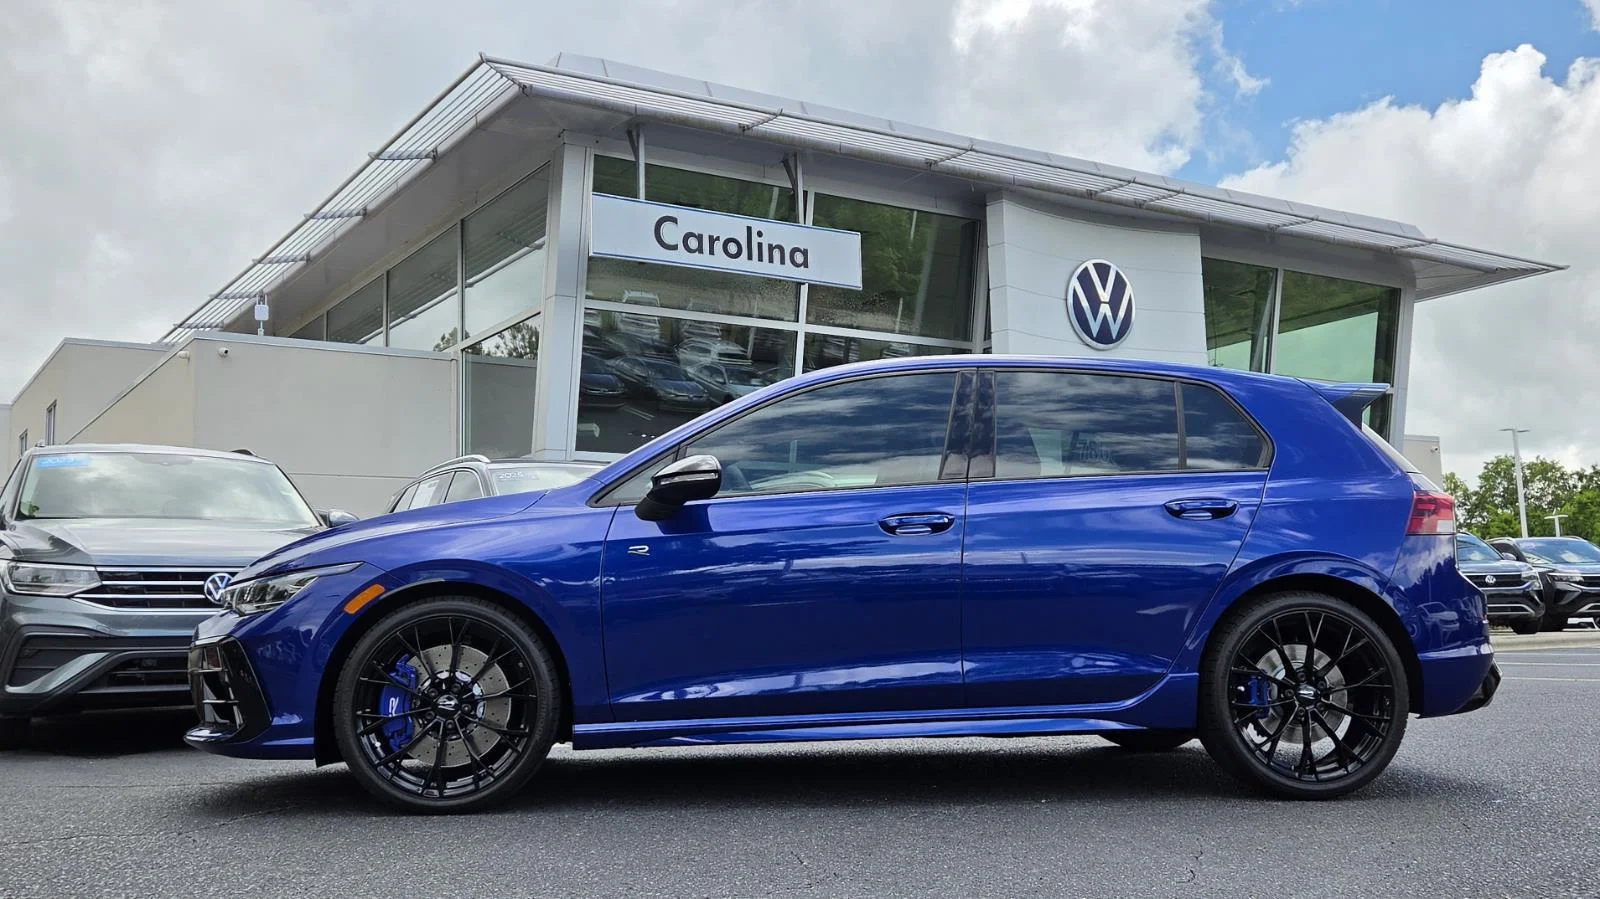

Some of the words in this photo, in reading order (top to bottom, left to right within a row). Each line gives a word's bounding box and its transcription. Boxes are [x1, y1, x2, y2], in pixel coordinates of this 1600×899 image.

[653, 215, 809, 269] Carolina
[1068, 260, 1134, 342] VW
[627, 545, 650, 556] R
